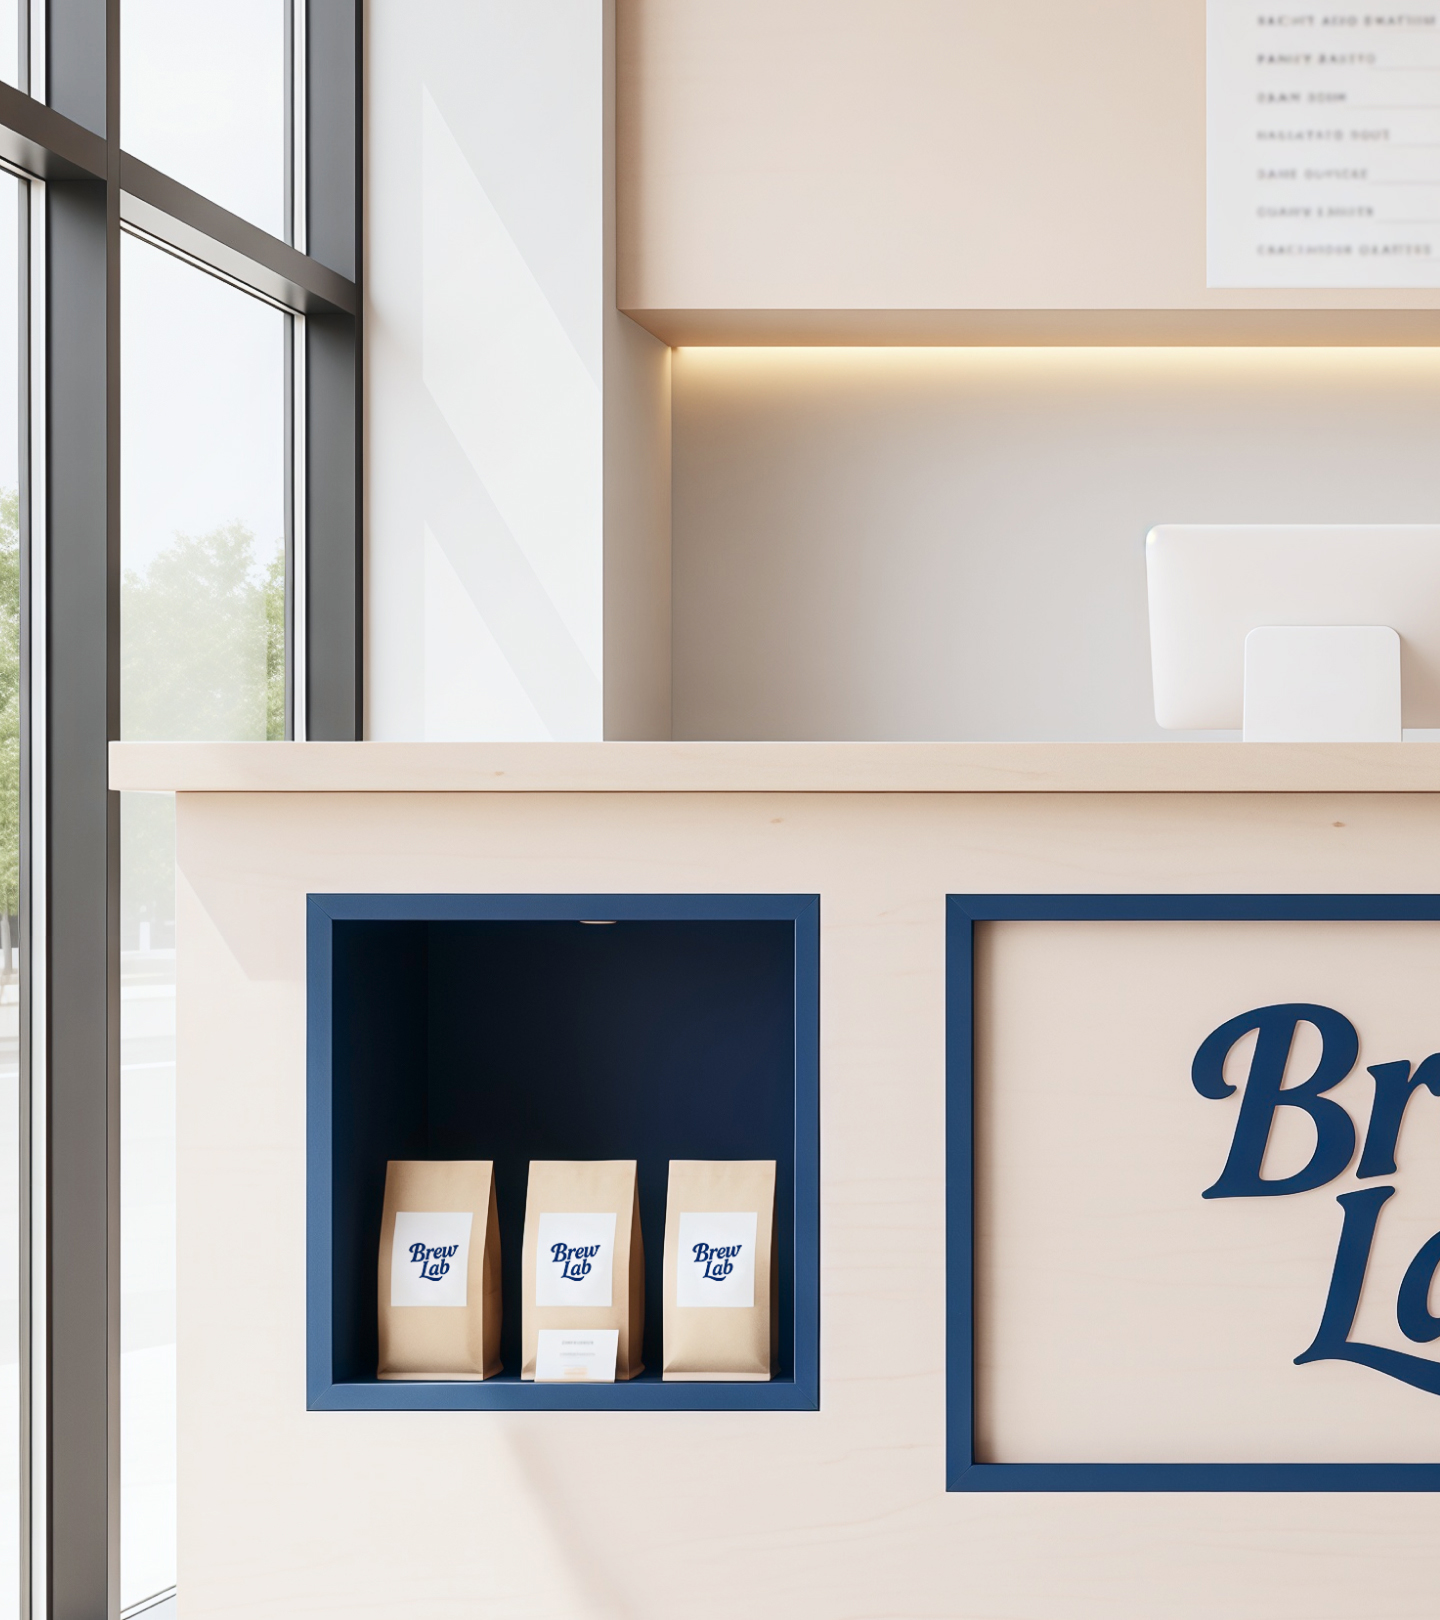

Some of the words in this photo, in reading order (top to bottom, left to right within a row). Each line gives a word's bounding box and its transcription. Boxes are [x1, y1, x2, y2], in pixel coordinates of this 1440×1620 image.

[409, 1243, 458, 1262] Brew
[551, 1243, 600, 1262] Brew
[692, 1243, 742, 1262] Brew
[419, 1258, 450, 1281] Lab
[561, 1258, 592, 1281] Lab
[703, 1258, 733, 1281] Lab
